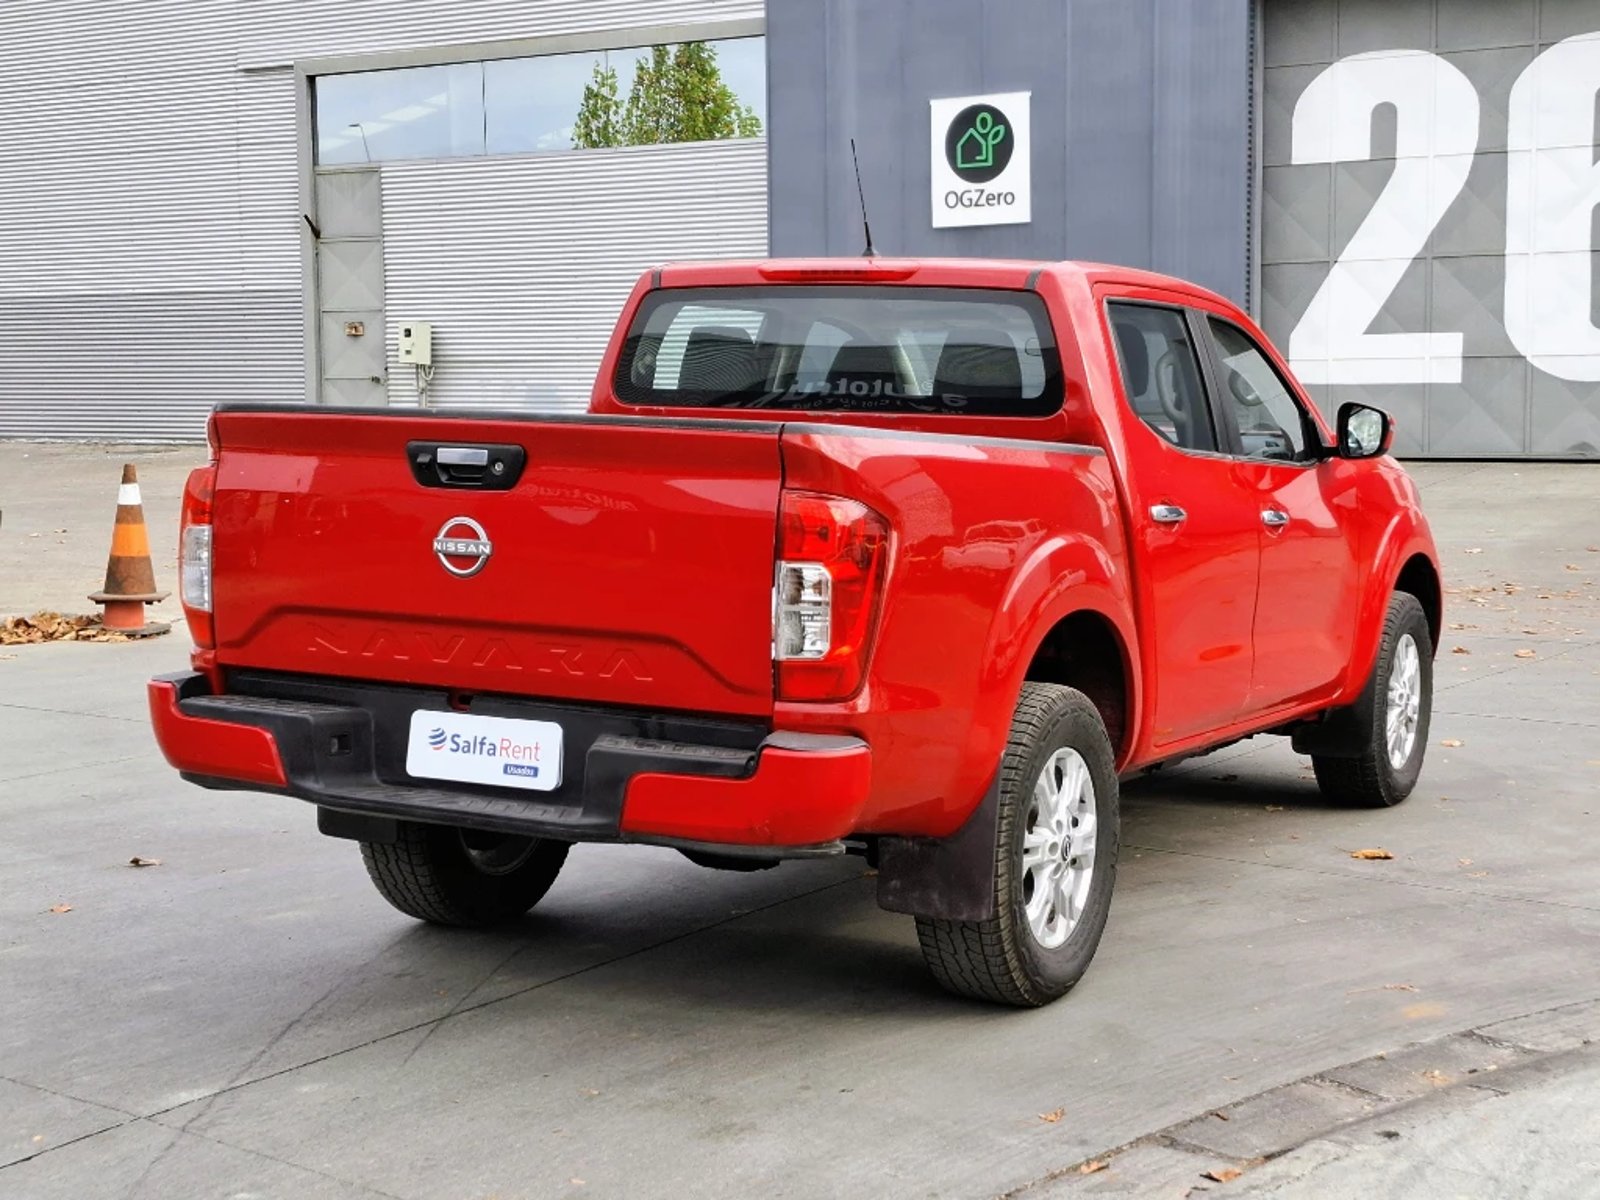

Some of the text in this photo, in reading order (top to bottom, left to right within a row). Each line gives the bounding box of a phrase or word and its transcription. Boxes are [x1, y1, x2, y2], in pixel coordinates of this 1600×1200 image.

[944, 188, 1016, 209] OGZero
[433, 541, 491, 554] NISSAN
[305, 622, 655, 682] NAVARA
[449, 733, 541, 762] SalfaRent
